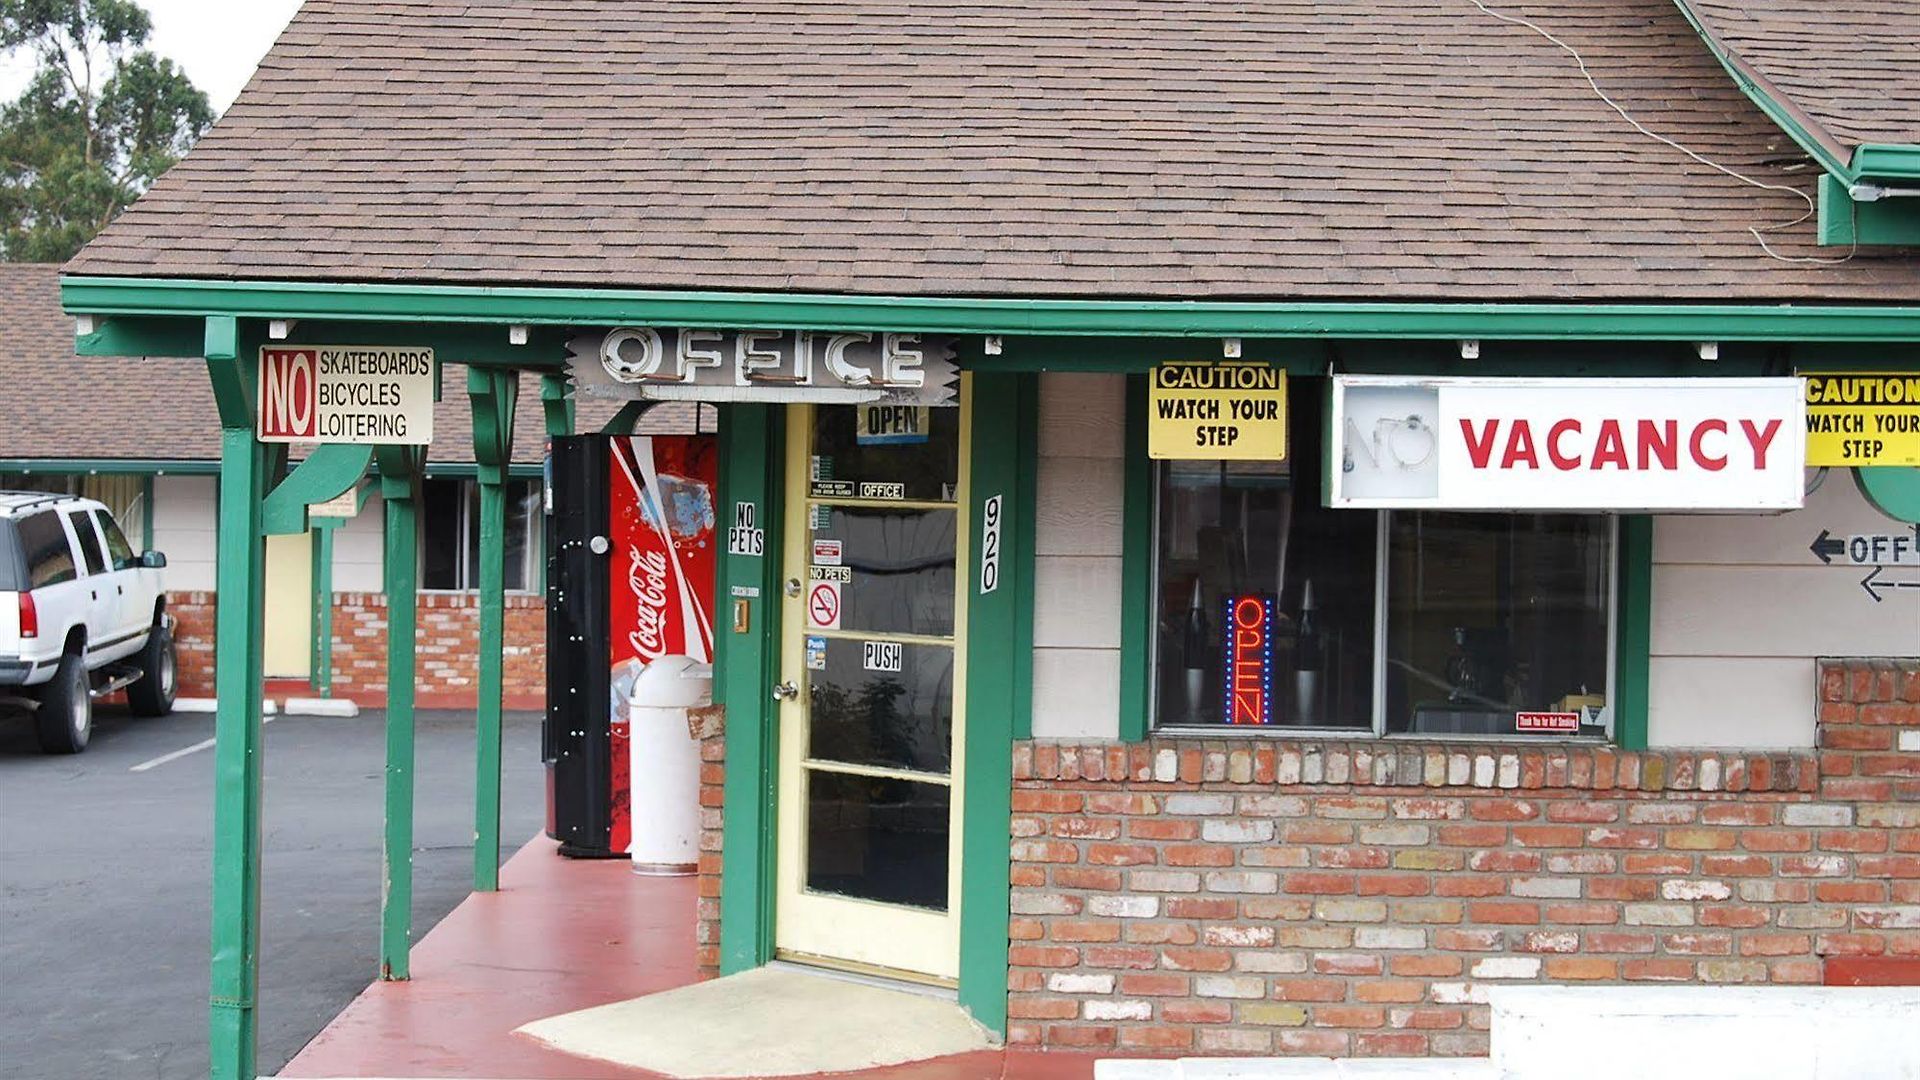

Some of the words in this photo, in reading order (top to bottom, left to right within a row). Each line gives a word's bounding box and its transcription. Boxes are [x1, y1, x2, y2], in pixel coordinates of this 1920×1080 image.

[320, 351, 429, 376] SKATEBOARDS
[600, 326, 925, 387] OFFICE
[1159, 366, 1276, 388] CAUTION
[266, 353, 312, 436] NO
[319, 383, 401, 406] BICYCLES
[1806, 378, 1920, 403] CAUTION
[867, 406, 918, 435] OPEN
[1157, 399, 1219, 419] WATCH
[1230, 400, 1278, 420] YOUR
[319, 413, 407, 436] LOITERING
[1196, 426, 1239, 446] STEP
[1806, 414, 1864, 433] WATCH
[1875, 414, 1920, 433] YOUR
[1459, 418, 1783, 471] VACANCY
[1843, 440, 1883, 458] STEP
[864, 485, 900, 497] OFFICE
[737, 503, 754, 528] NO
[730, 529, 763, 554] PETS
[984, 499, 998, 590] 920
[1850, 536, 1913, 562] OFF
[810, 567, 822, 580] NO
[825, 567, 849, 581] PETS
[865, 643, 900, 670] PUSH
[1235, 598, 1263, 724] OPEN
